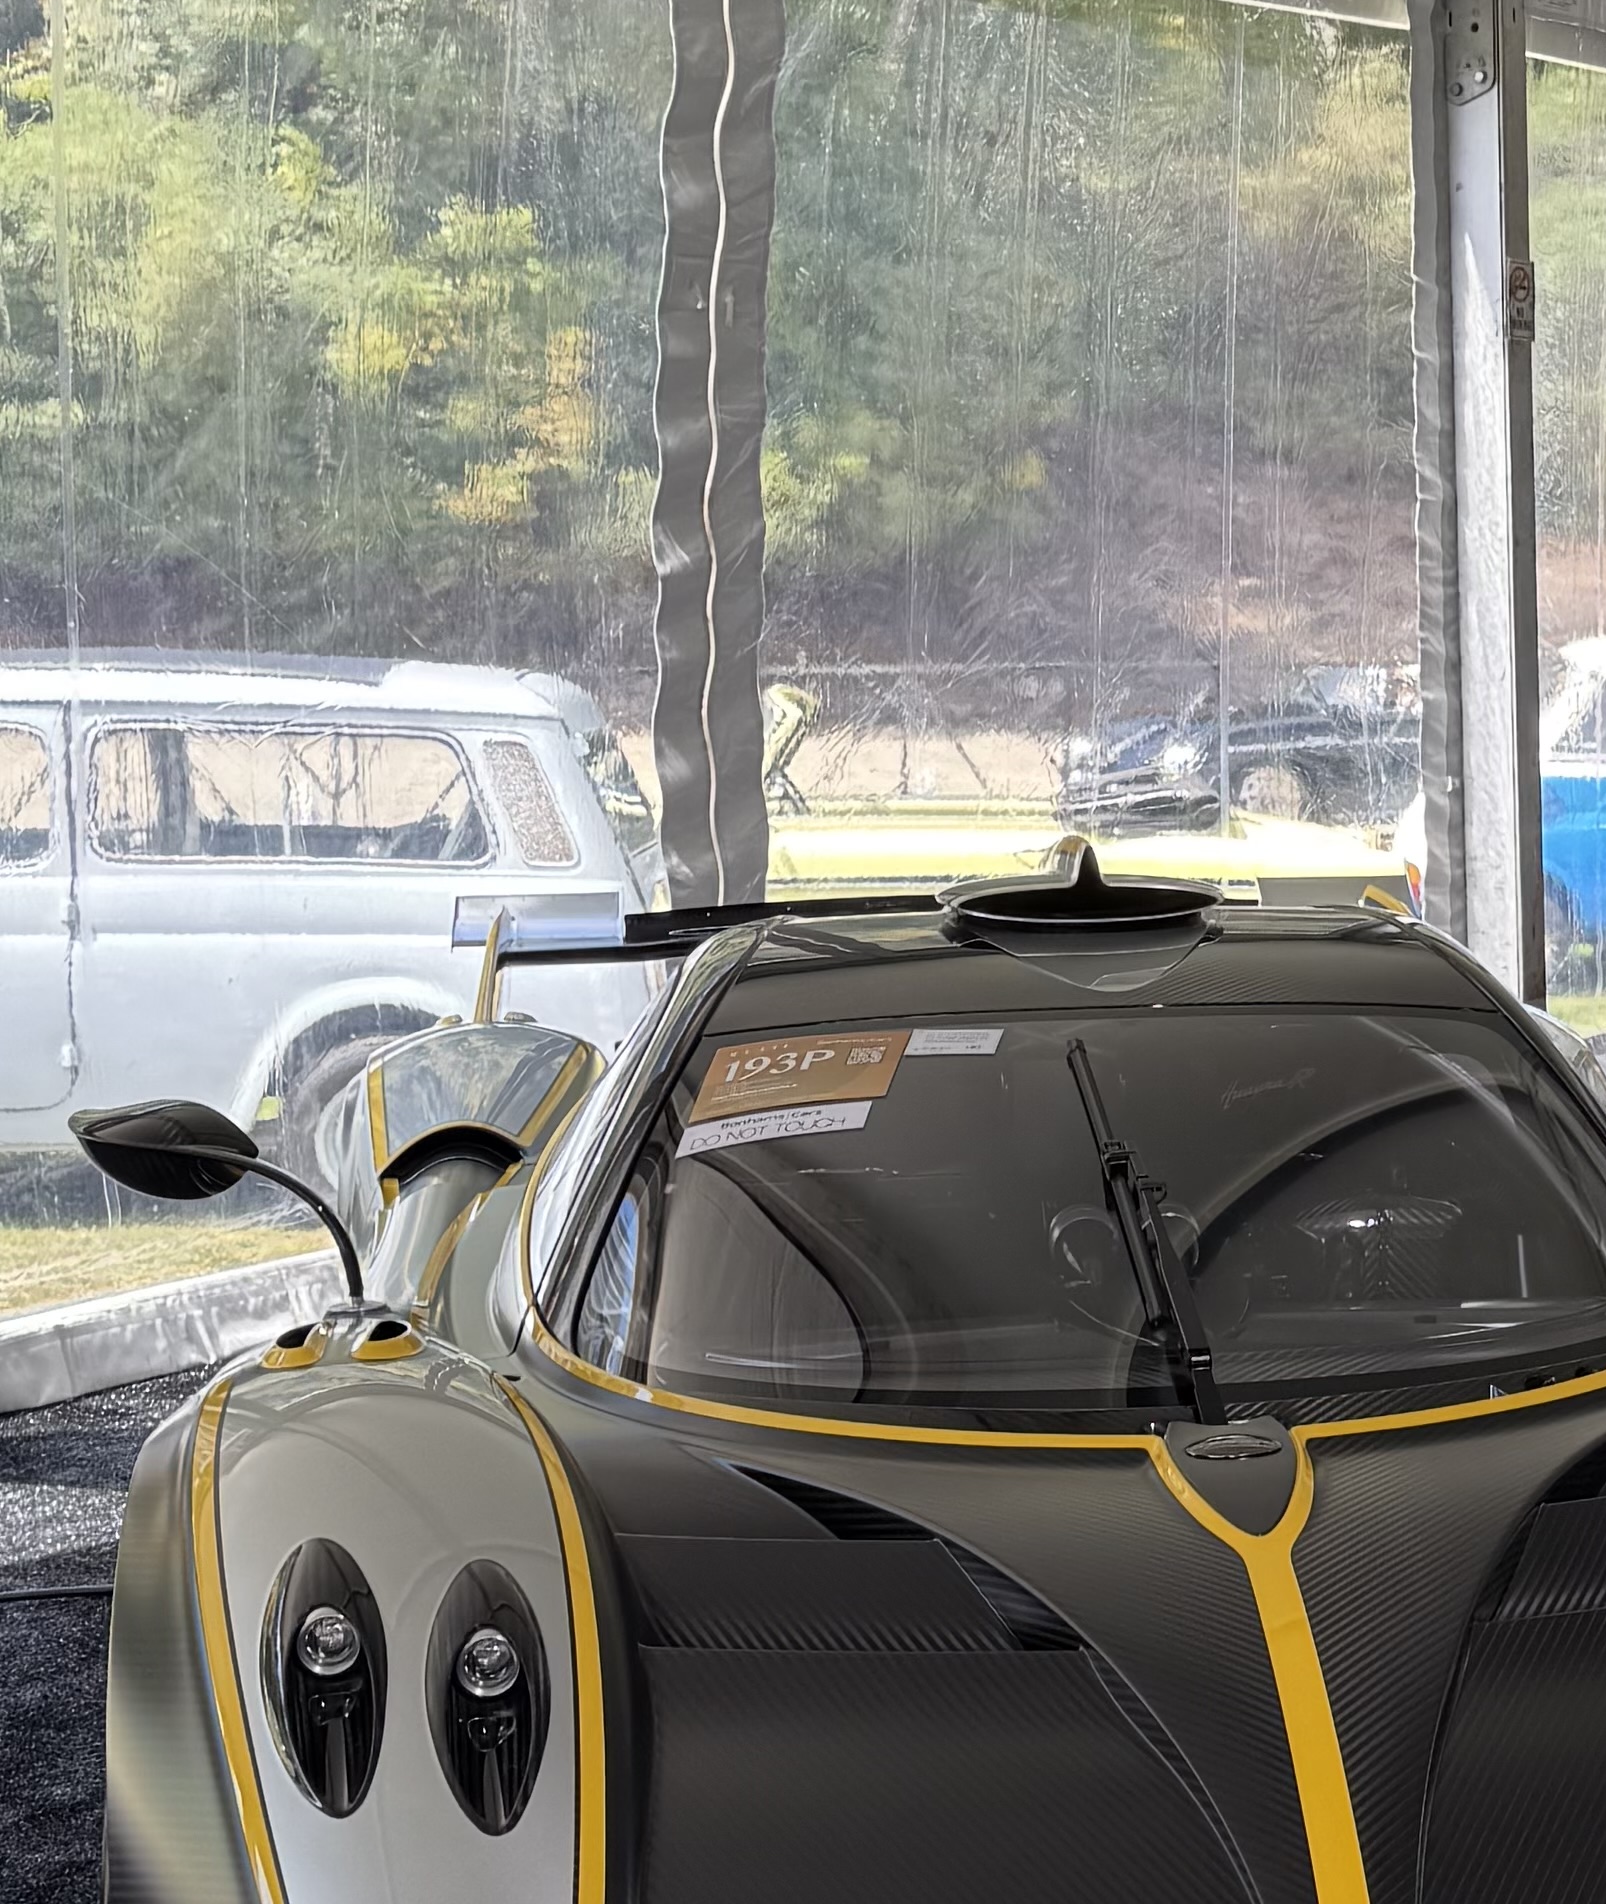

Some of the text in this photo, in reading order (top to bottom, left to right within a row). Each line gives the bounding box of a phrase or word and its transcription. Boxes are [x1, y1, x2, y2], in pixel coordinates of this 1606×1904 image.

[724, 1049, 837, 1083] 193P
[689, 1116, 846, 1151] DO NOT TOUCH
